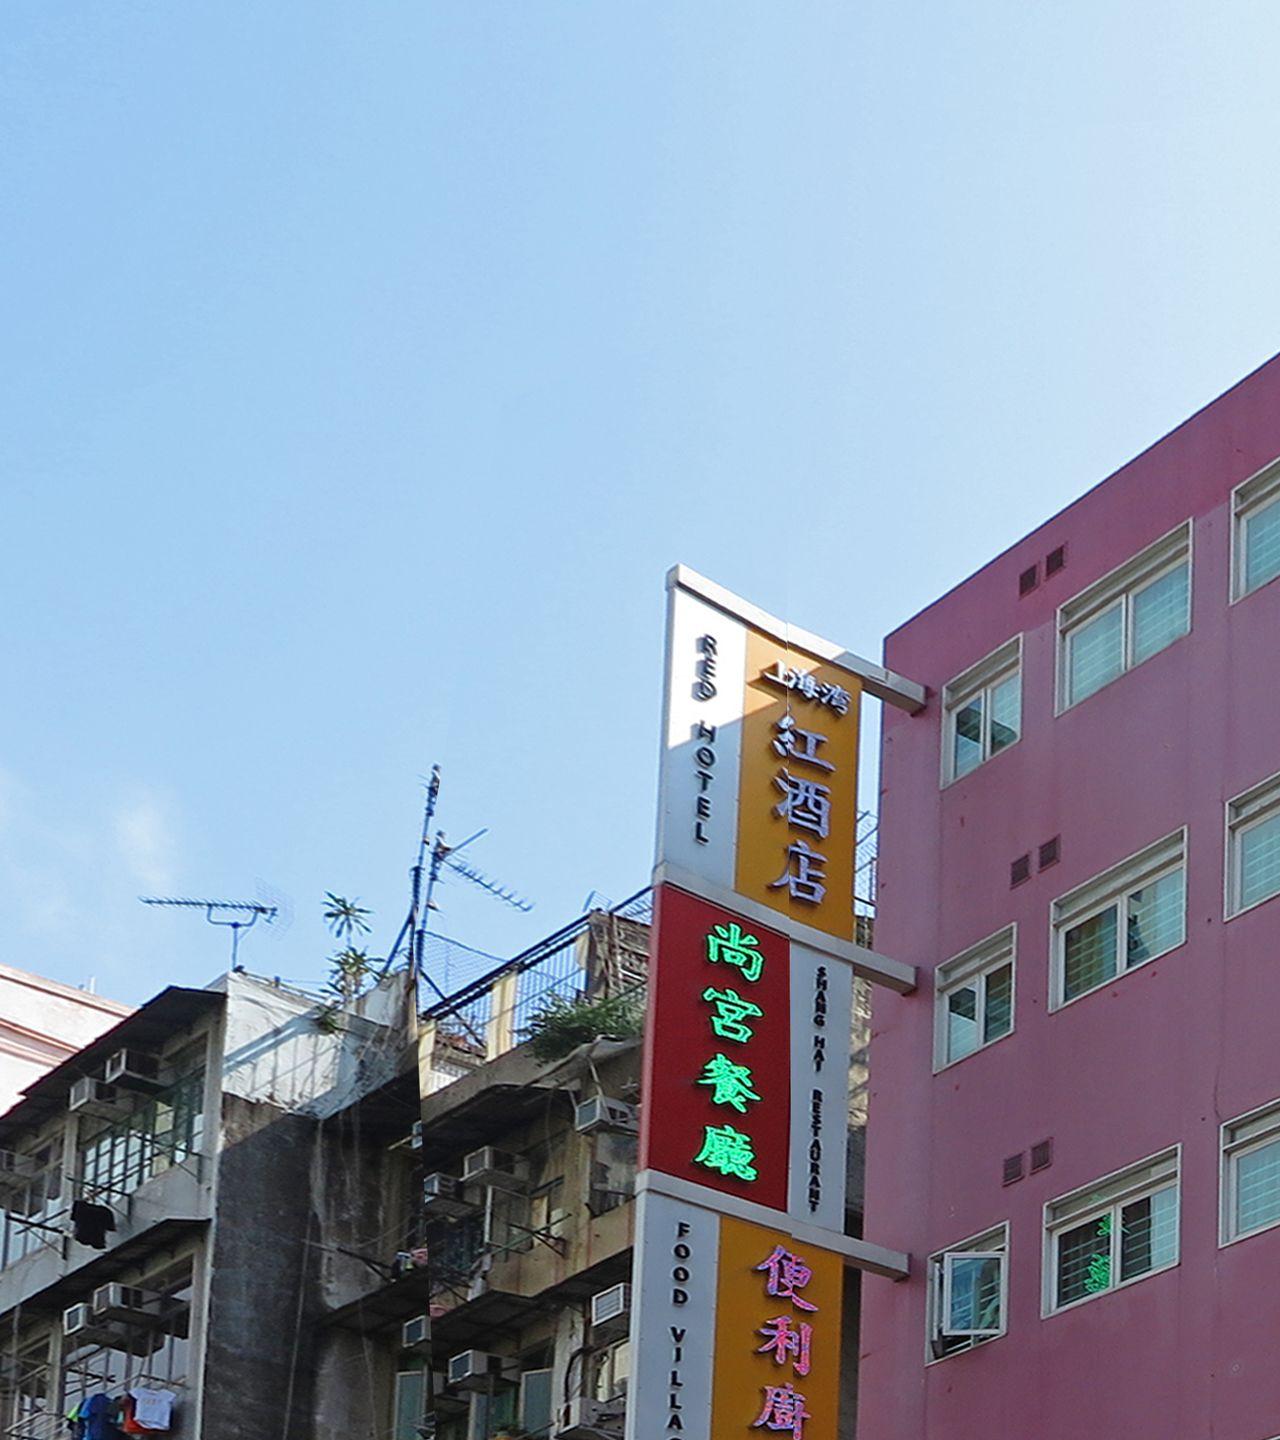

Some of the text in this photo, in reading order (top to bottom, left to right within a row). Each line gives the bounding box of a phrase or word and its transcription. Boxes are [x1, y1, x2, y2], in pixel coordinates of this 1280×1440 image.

[694, 634, 718, 846] RED HOTEL
[693, 922, 765, 1182] 尚宮餐廳
[807, 966, 828, 1214] SHANG HAI RESTAURANT
[672, 1221, 691, 1307] FOOD
